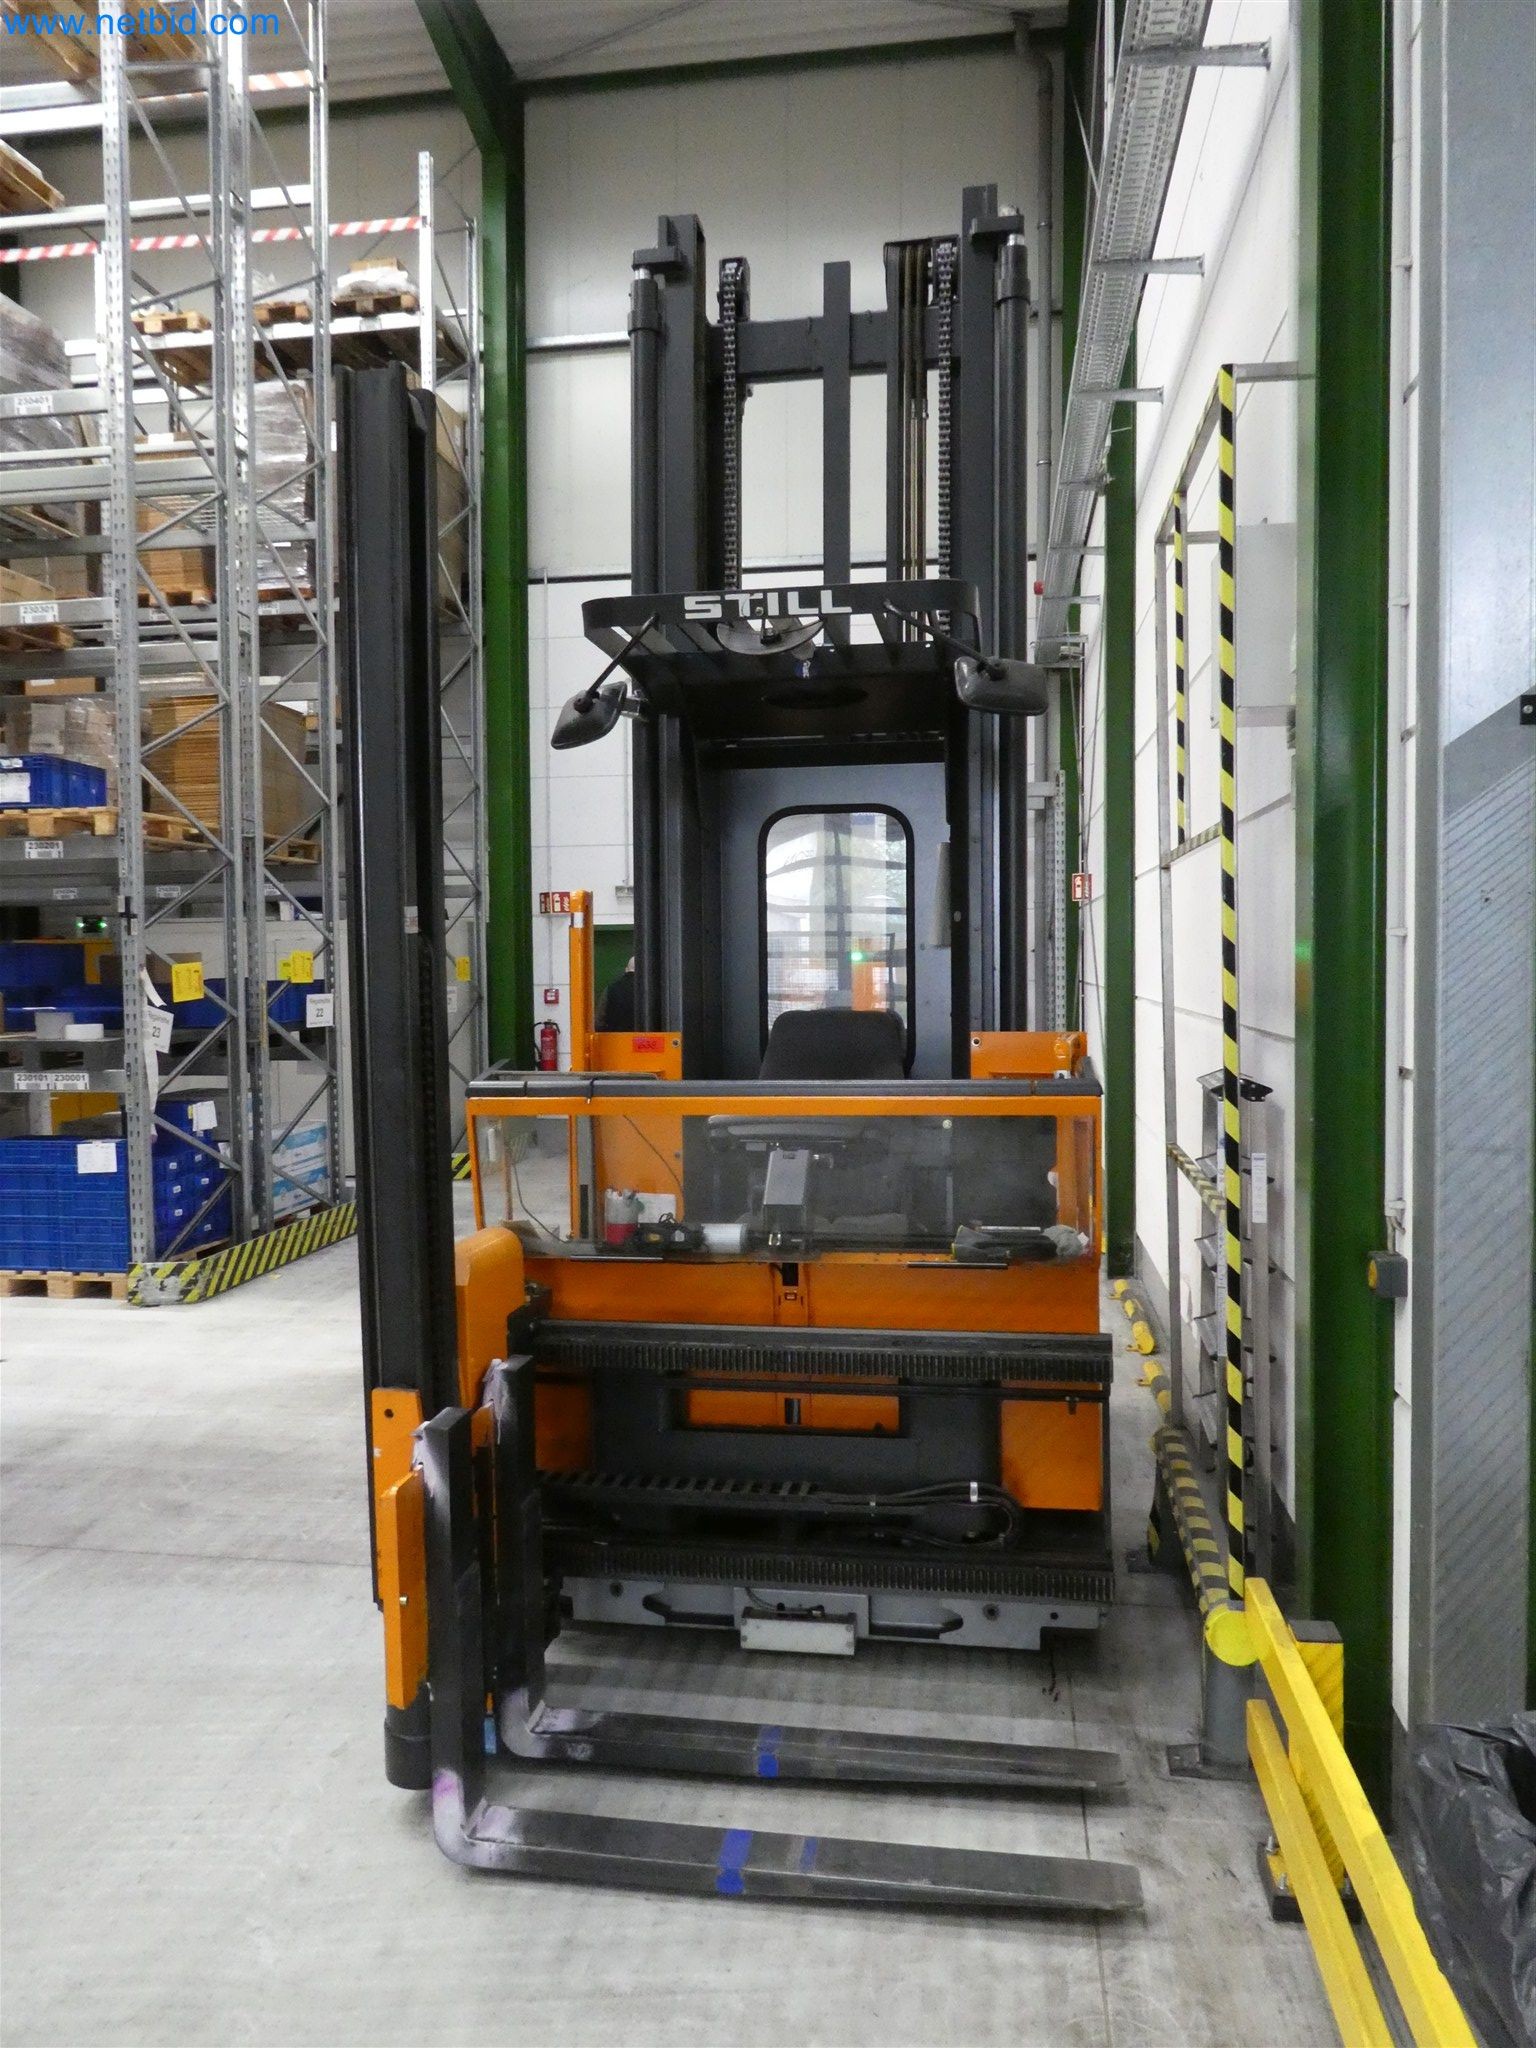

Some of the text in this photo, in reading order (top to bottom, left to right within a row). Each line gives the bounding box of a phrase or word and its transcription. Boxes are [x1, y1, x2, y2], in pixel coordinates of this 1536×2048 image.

[684, 589, 853, 620] STILL
[23, 605, 55, 614] 230301
[28, 841, 60, 850] 230201
[315, 1008, 324, 1018] 22
[152, 1025, 161, 1039] 23
[16, 1074, 86, 1082] 230101 230001
